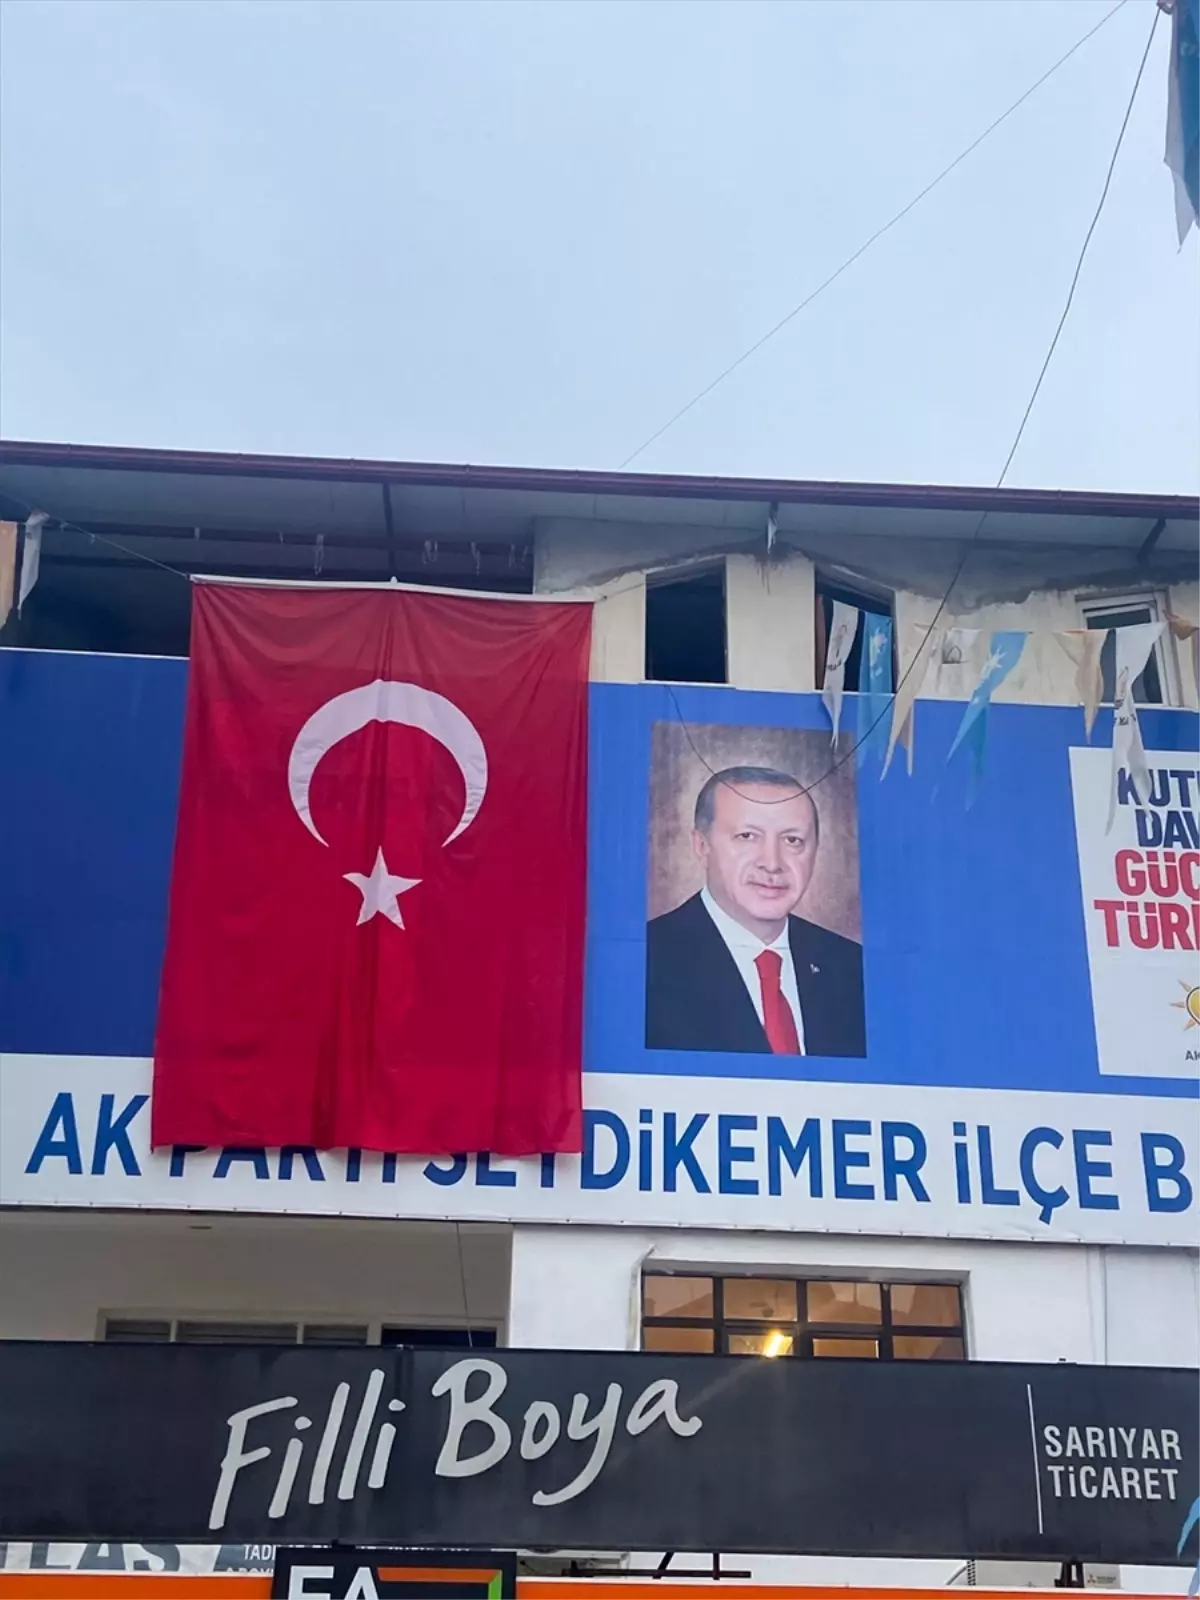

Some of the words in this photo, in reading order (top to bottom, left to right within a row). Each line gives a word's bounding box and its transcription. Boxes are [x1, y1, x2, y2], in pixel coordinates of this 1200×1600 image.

[1118, 767, 1200, 807] KUT
[25, 1092, 149, 1176] AK
[1140, 1132, 1193, 1213] B
[208, 1368, 406, 1530] Filli
[431, 1358, 702, 1506] Boya
[1043, 1425, 1182, 1460] SARIYAR
